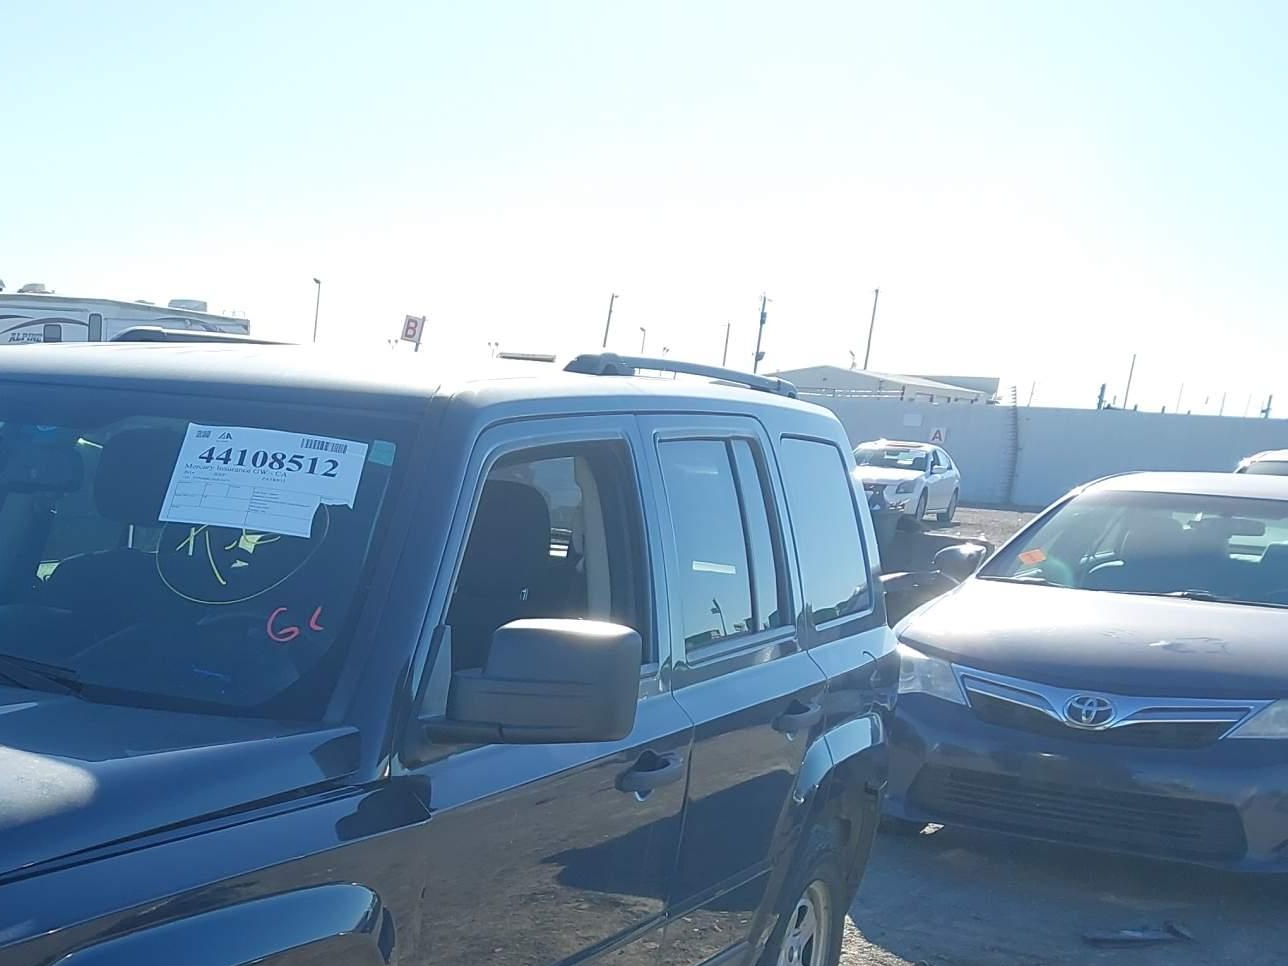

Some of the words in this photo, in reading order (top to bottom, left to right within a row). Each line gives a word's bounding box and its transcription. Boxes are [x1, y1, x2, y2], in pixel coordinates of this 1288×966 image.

[404, 318, 418, 339] B
[931, 429, 943, 441] A
[184, 463, 213, 472] Mercury
[216, 465, 252, 474] Insurance
[198, 446, 340, 477] 44108512
